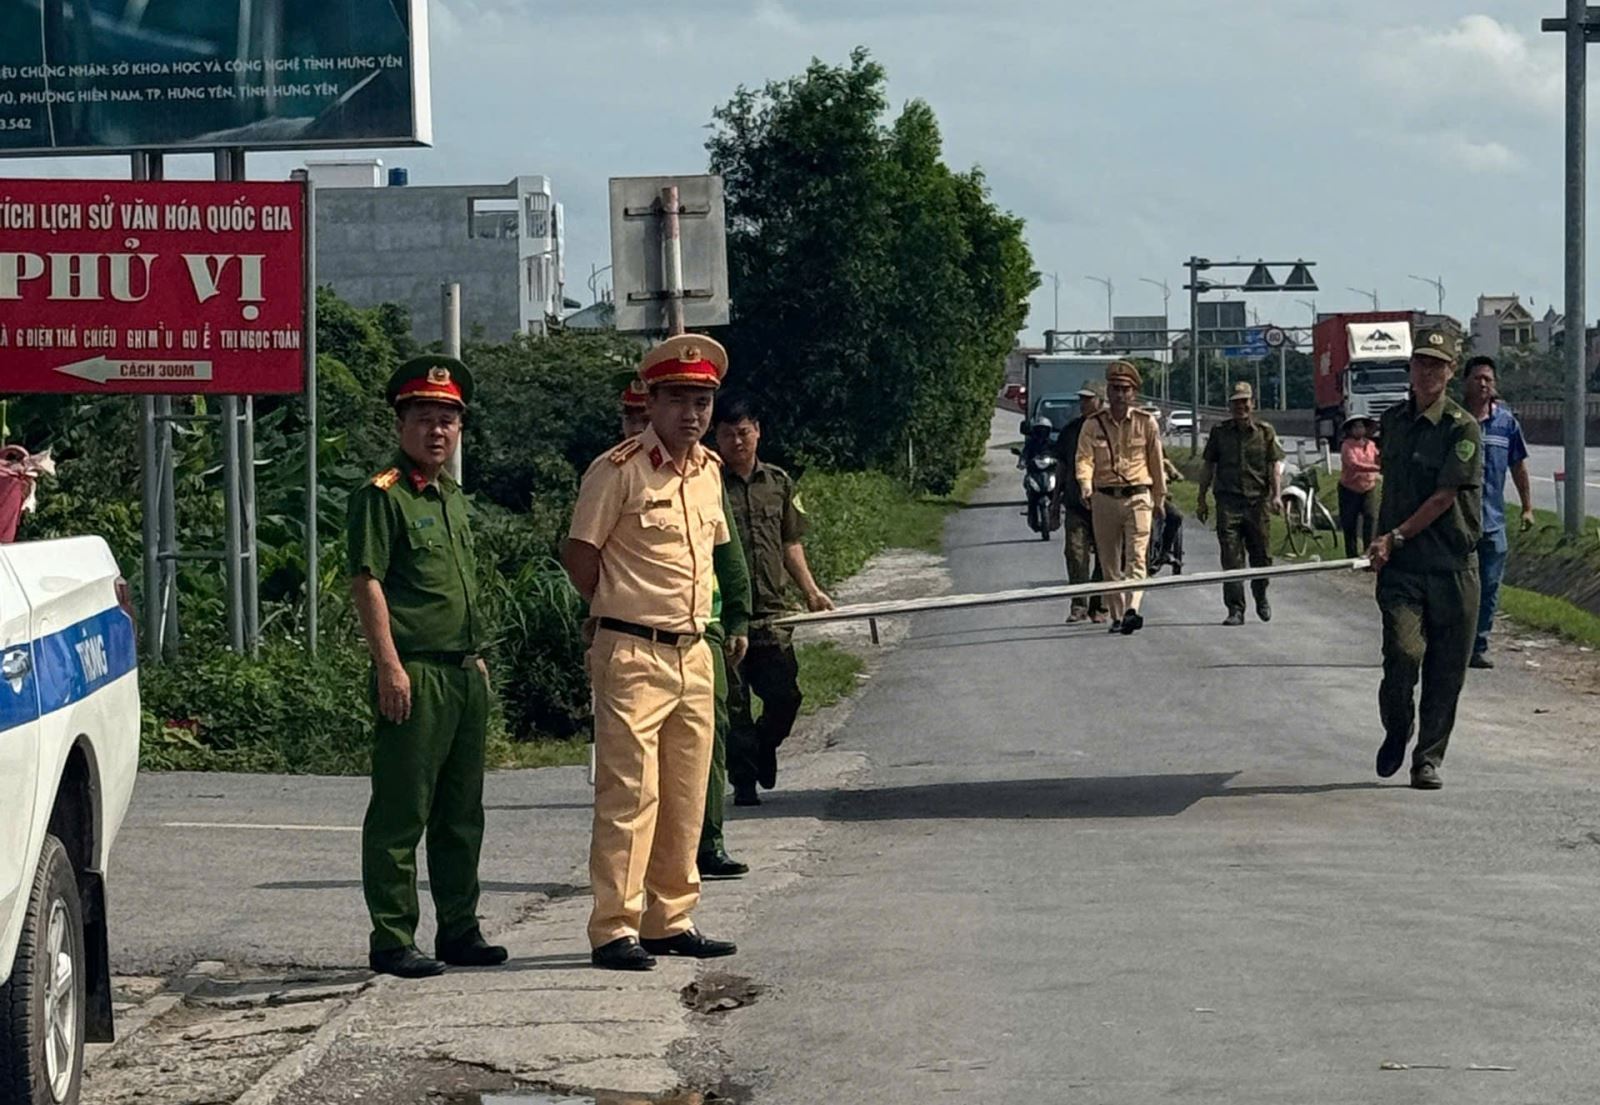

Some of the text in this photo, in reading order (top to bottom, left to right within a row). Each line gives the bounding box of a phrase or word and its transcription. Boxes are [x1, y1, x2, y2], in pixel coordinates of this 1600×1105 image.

[132, 62, 170, 75] KHOA
[172, 61, 201, 75] HỌC
[203, 59, 222, 73] VÀ
[337, 55, 375, 69] HƯNG
[377, 53, 403, 68] YÊN
[313, 82, 338, 96] YÊN
[40, 203, 82, 235] LỊCH
[88, 194, 115, 230] SỬ
[120, 198, 158, 231] VĂN
[164, 199, 202, 231] HÓA
[206, 195, 256, 233] QUỐC
[261, 205, 293, 231] GIA
[0, 237, 266, 321] PHỦ VỊ
[240, 330, 271, 352] NGỌC
[158, 364, 195, 378] 300M
